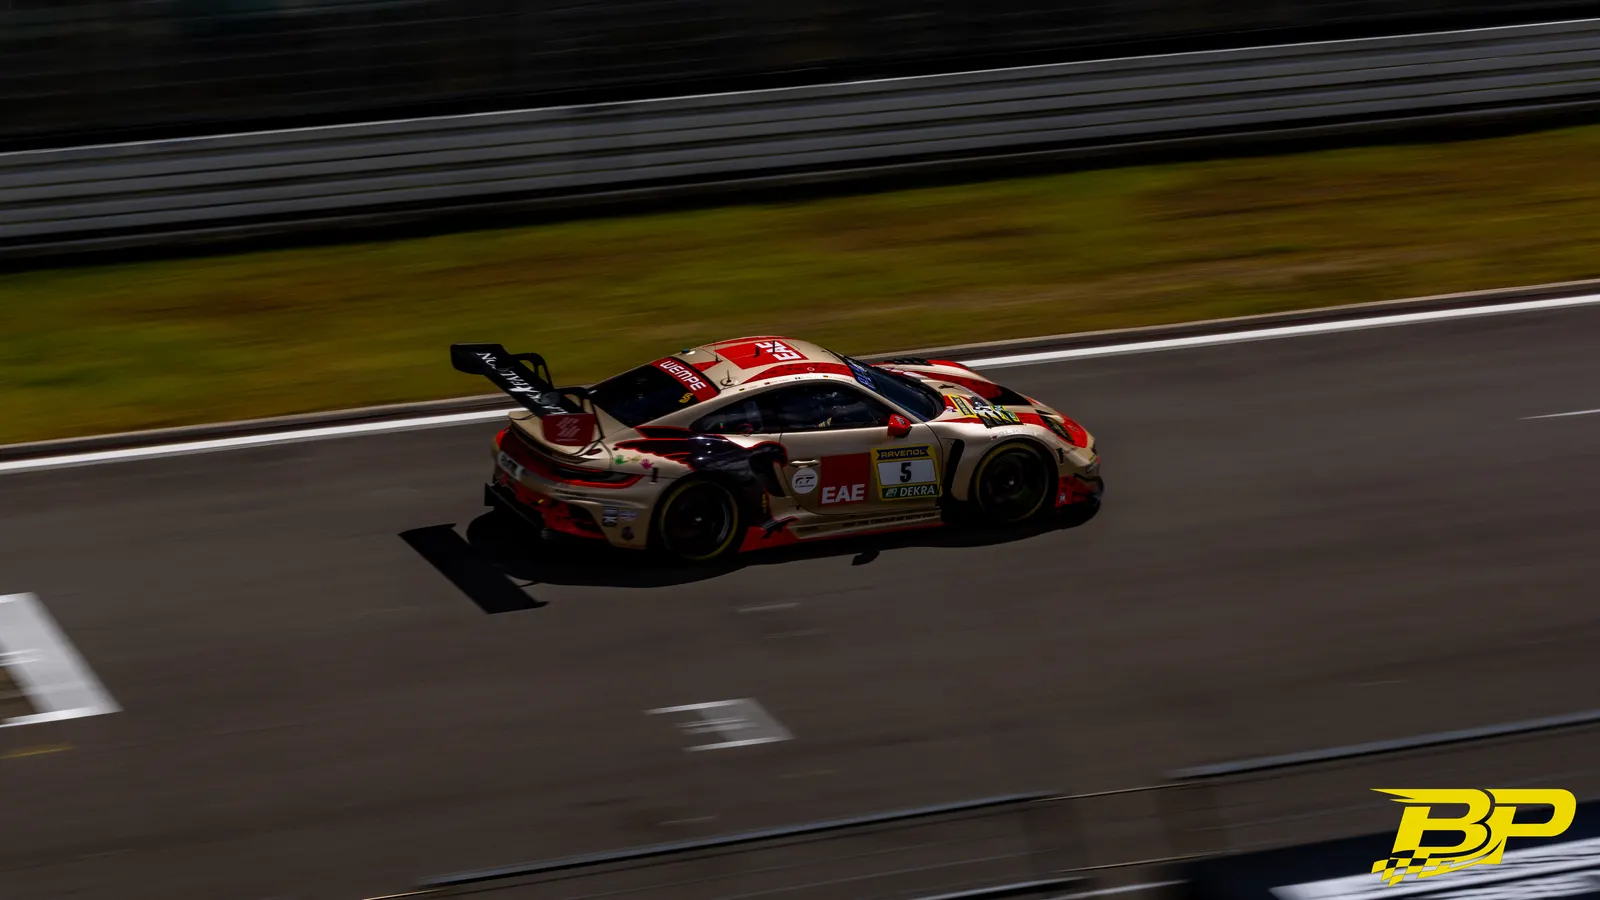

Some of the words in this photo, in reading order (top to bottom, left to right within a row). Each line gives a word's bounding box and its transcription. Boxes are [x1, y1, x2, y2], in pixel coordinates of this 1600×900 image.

[659, 360, 707, 391] WEMPE
[880, 447, 927, 458] RAVENOL
[899, 462, 912, 483] 5
[821, 483, 866, 504] EAE
[899, 485, 935, 497] DEKRA
